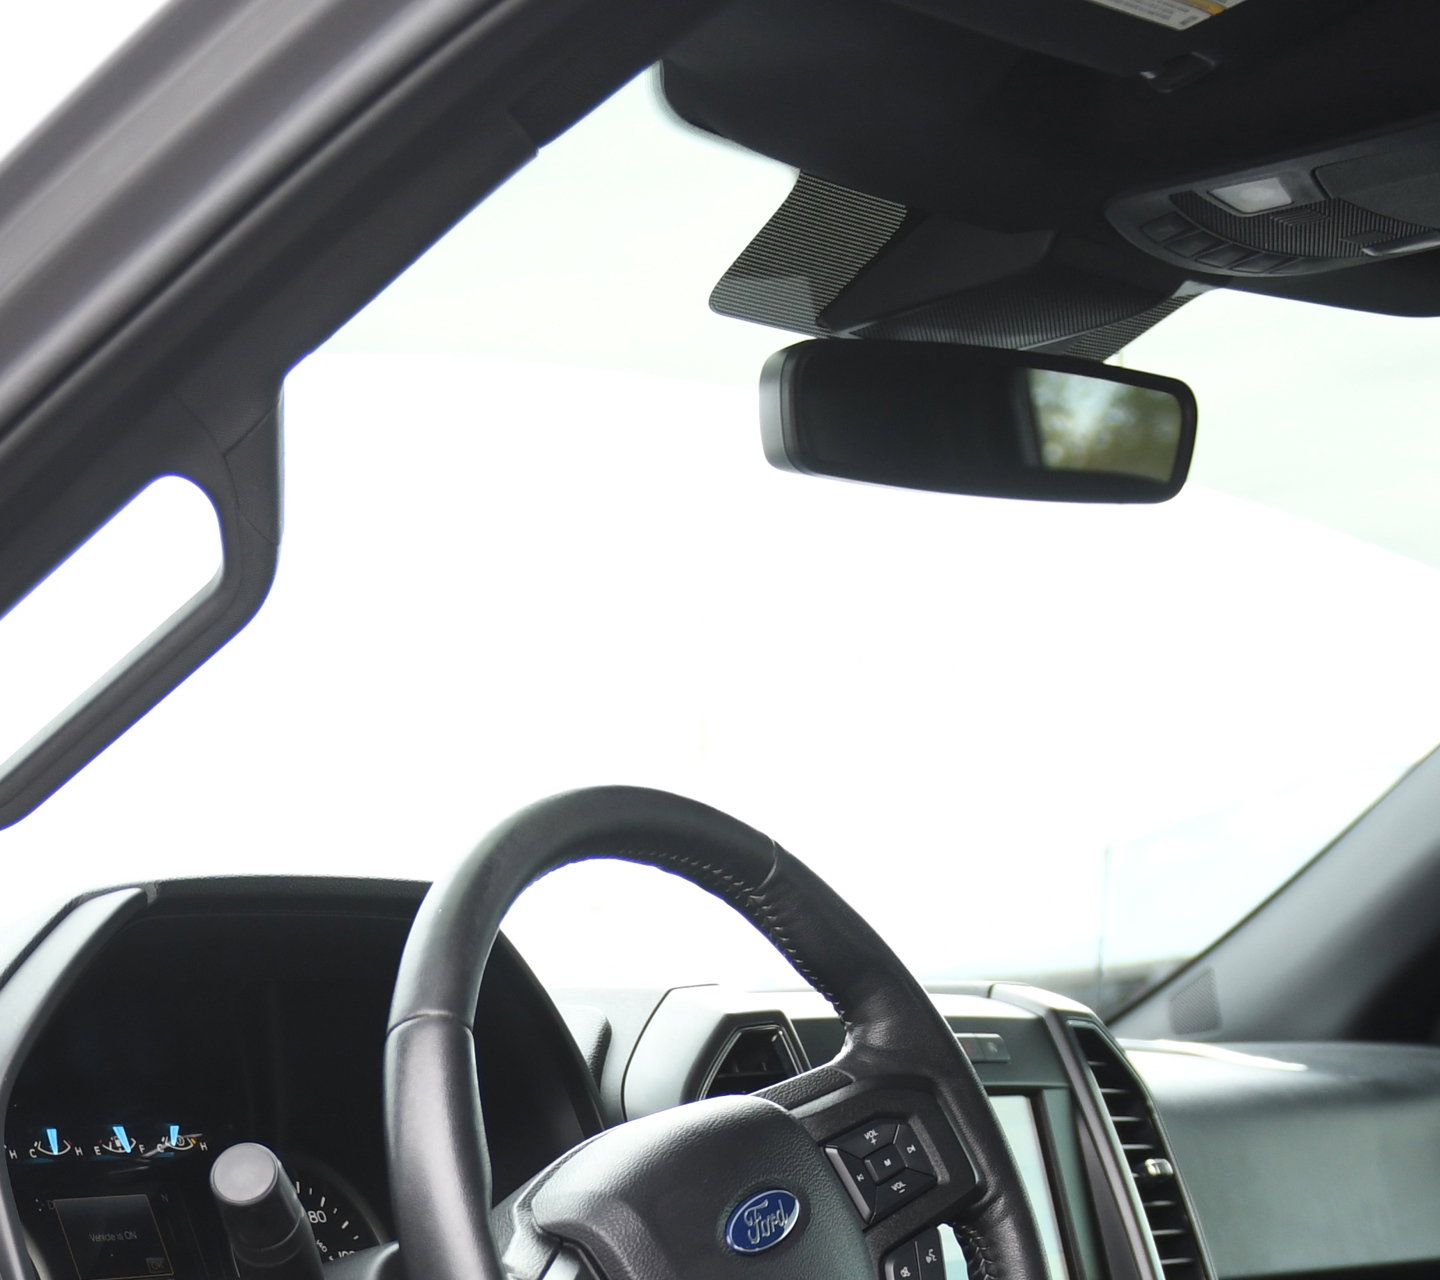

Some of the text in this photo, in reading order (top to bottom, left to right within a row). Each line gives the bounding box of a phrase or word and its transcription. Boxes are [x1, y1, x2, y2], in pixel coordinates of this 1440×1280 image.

[864, 1129, 879, 1140] VOL
[29, 1146, 84, 1159] C H
[94, 1144, 146, 1156] E F
[199, 1142, 209, 1151] H
[891, 1181, 907, 1191] VOL
[307, 1210, 327, 1223] 80
[744, 1199, 789, 1244] Ford
